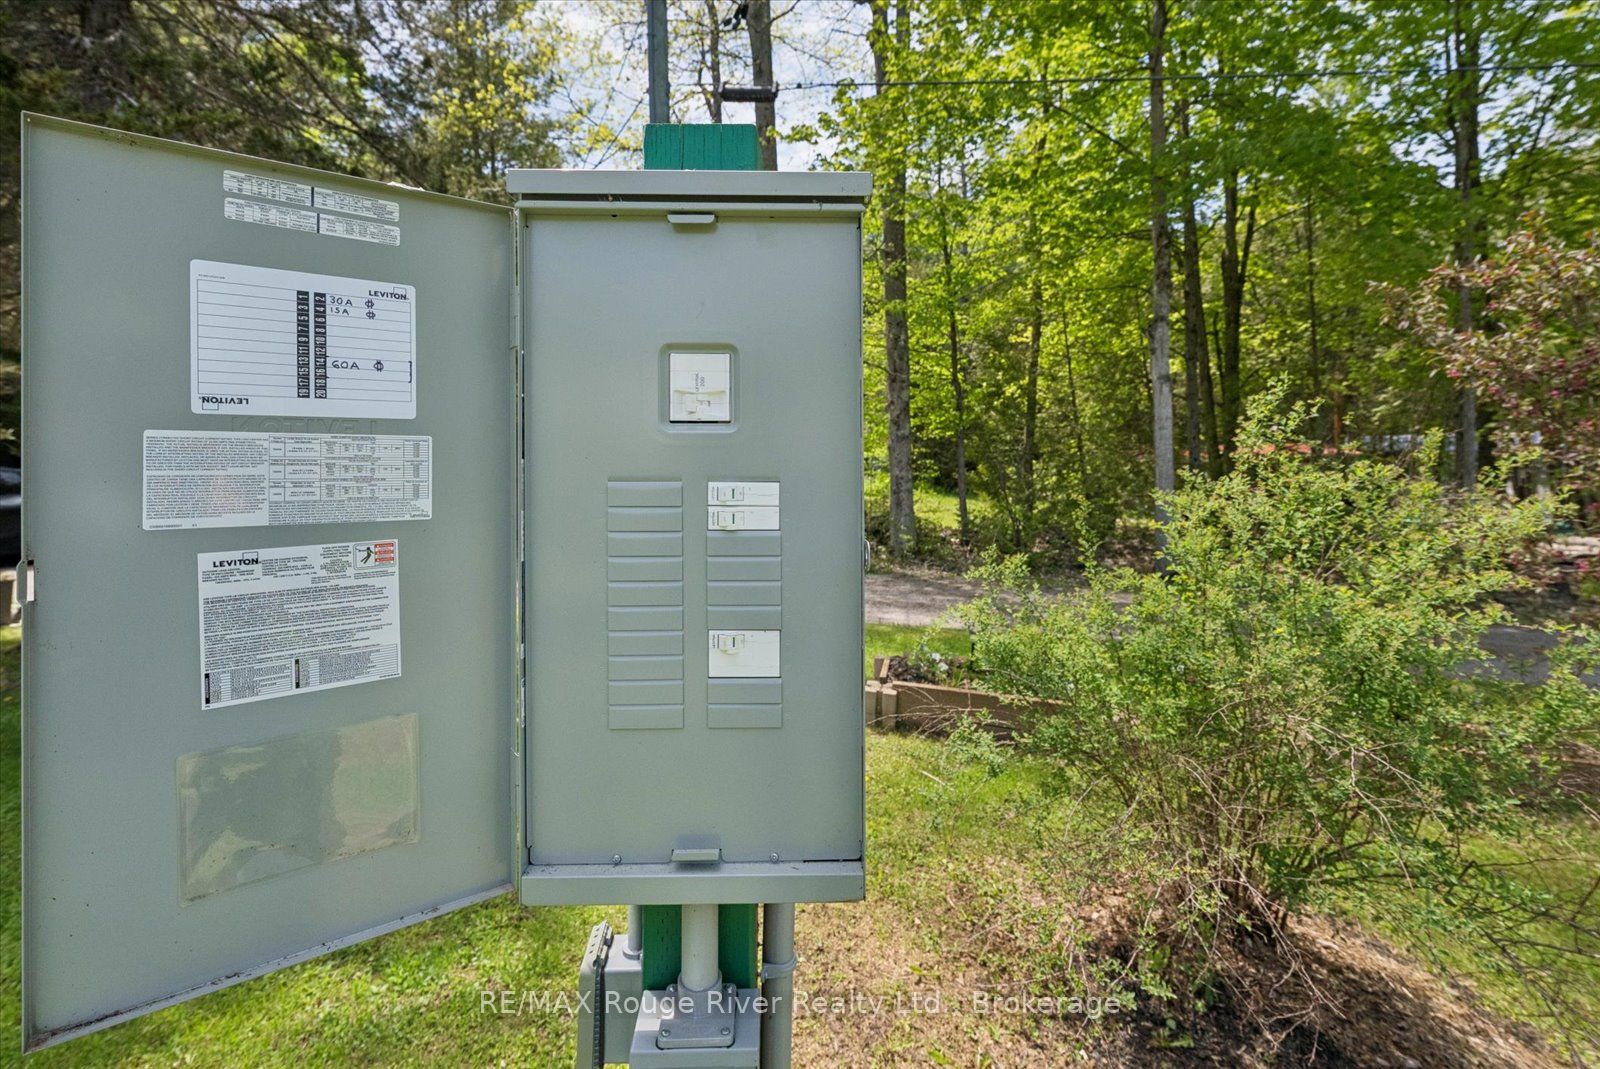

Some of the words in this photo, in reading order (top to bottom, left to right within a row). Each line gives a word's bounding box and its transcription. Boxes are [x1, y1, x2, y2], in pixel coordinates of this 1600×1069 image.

[369, 290, 407, 300] LEVITON
[329, 296, 353, 306] 30A
[330, 307, 349, 316] 15A
[332, 360, 360, 370] 60A
[315, 368, 326, 376] 16
[315, 389, 326, 398] 20
[202, 396, 249, 405] LEVITON
[213, 557, 259, 568] LEVITON
